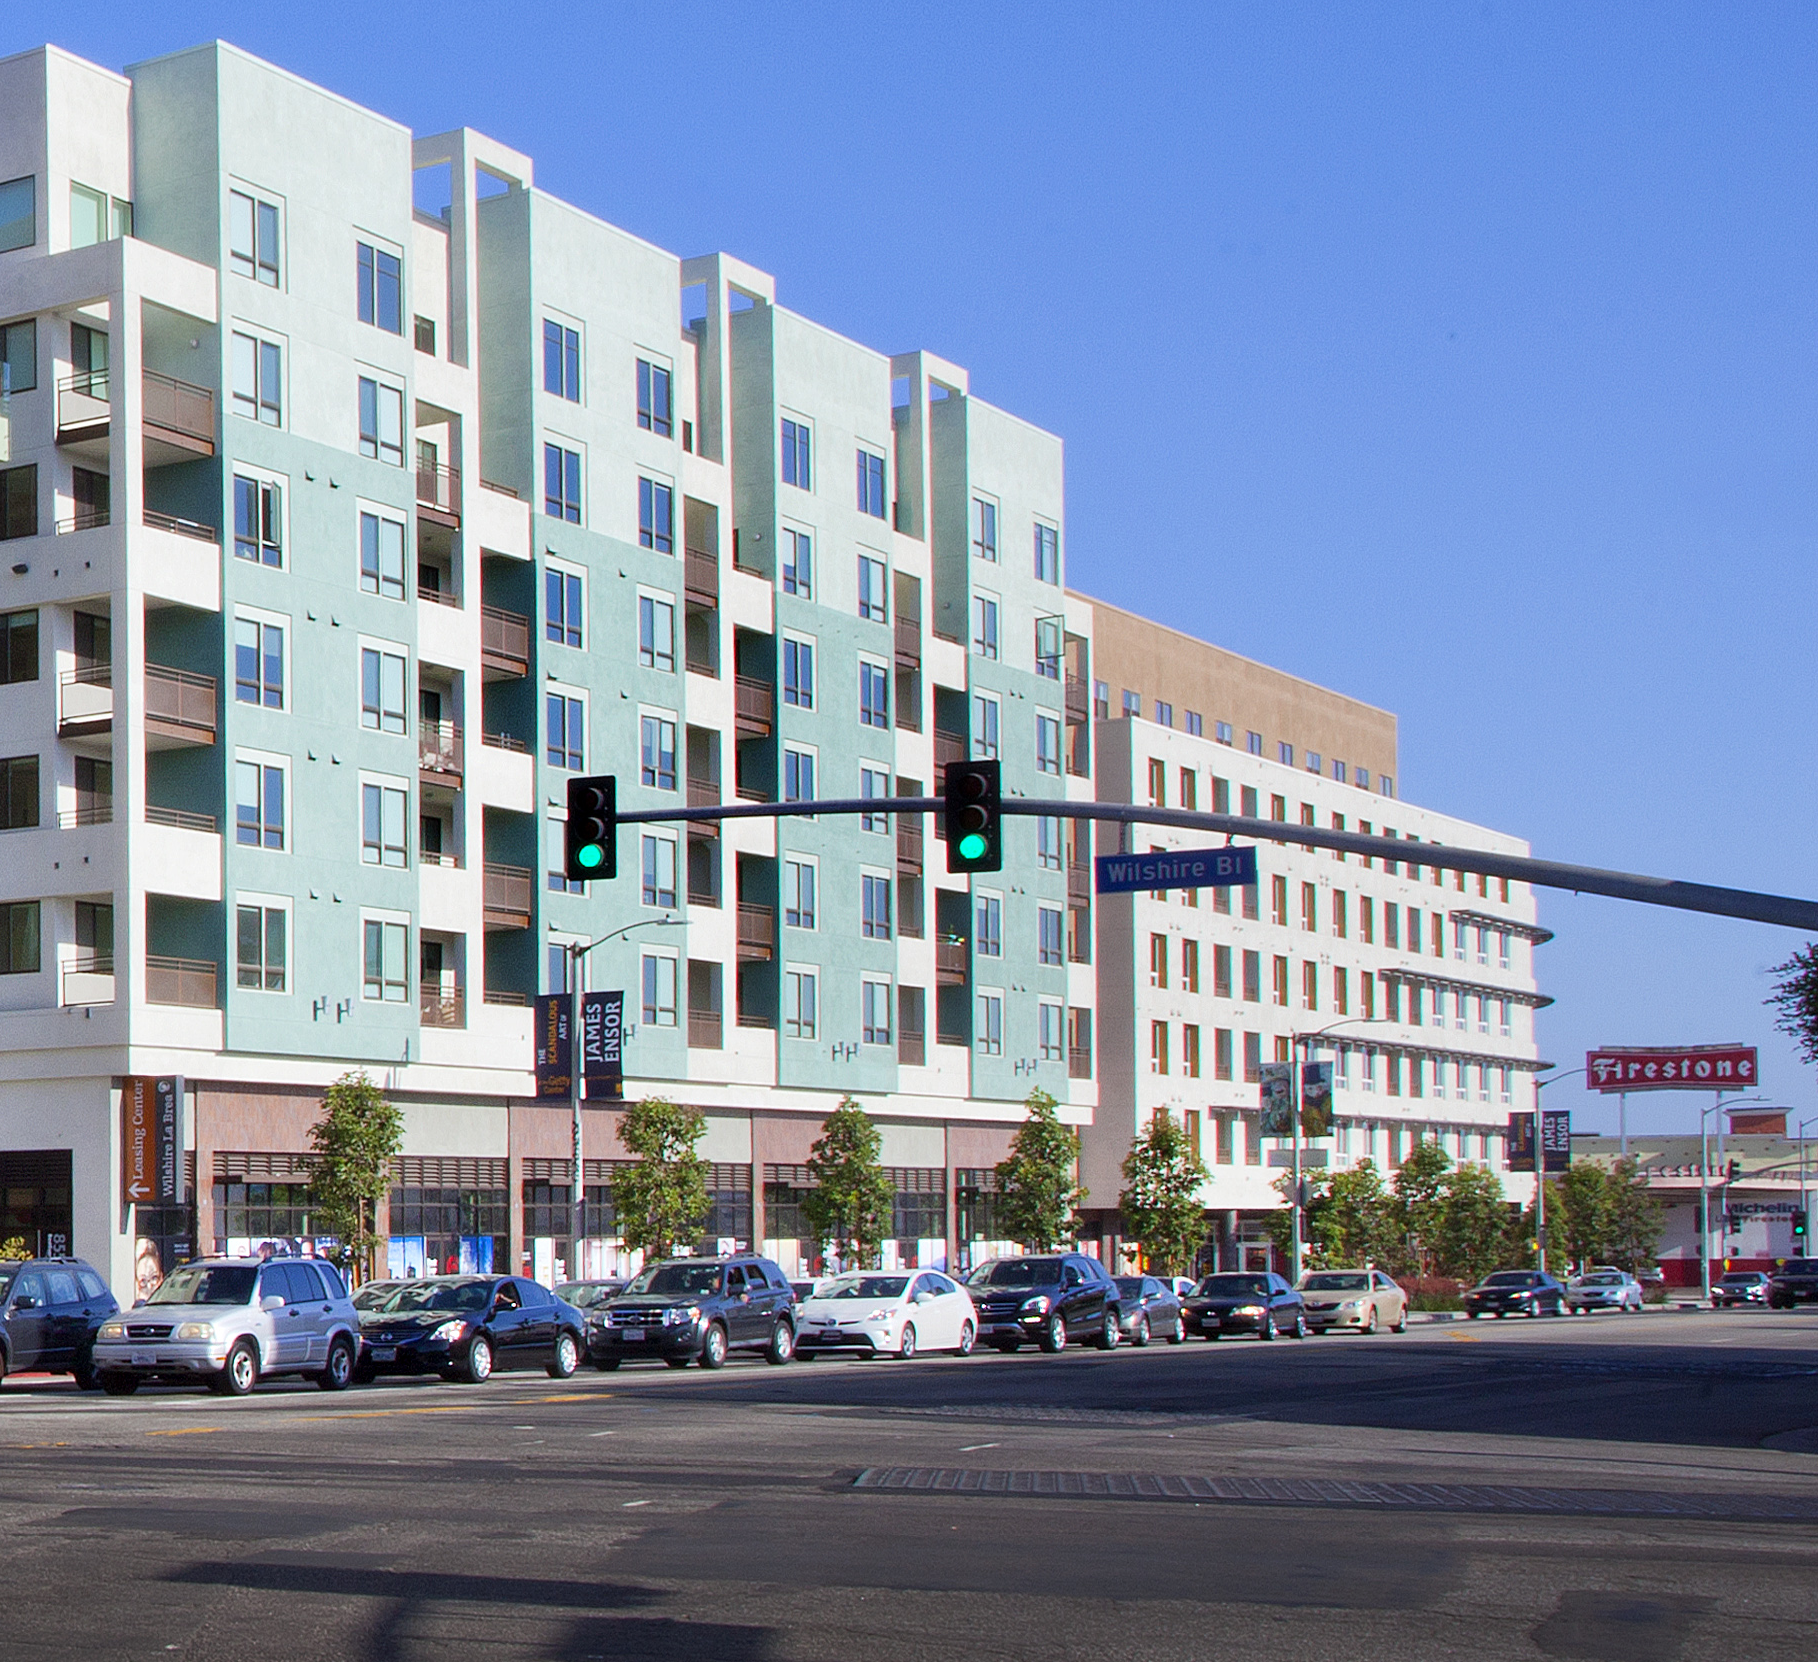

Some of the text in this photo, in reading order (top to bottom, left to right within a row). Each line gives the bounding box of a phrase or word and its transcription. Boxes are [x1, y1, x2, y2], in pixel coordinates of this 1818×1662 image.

[1107, 855, 1243, 884] Wilshire Bl
[585, 1003, 604, 1063] JAMES
[604, 1000, 621, 1062] ENSOR
[1591, 1056, 1753, 1083] Firestone
[132, 1080, 146, 1180] Leasing Center
[163, 1094, 174, 1197] Wilshire La Brea
[1544, 1117, 1557, 1151] JAMES
[1557, 1116, 1569, 1152] ENSOR
[53, 1233, 66, 1258] 85
